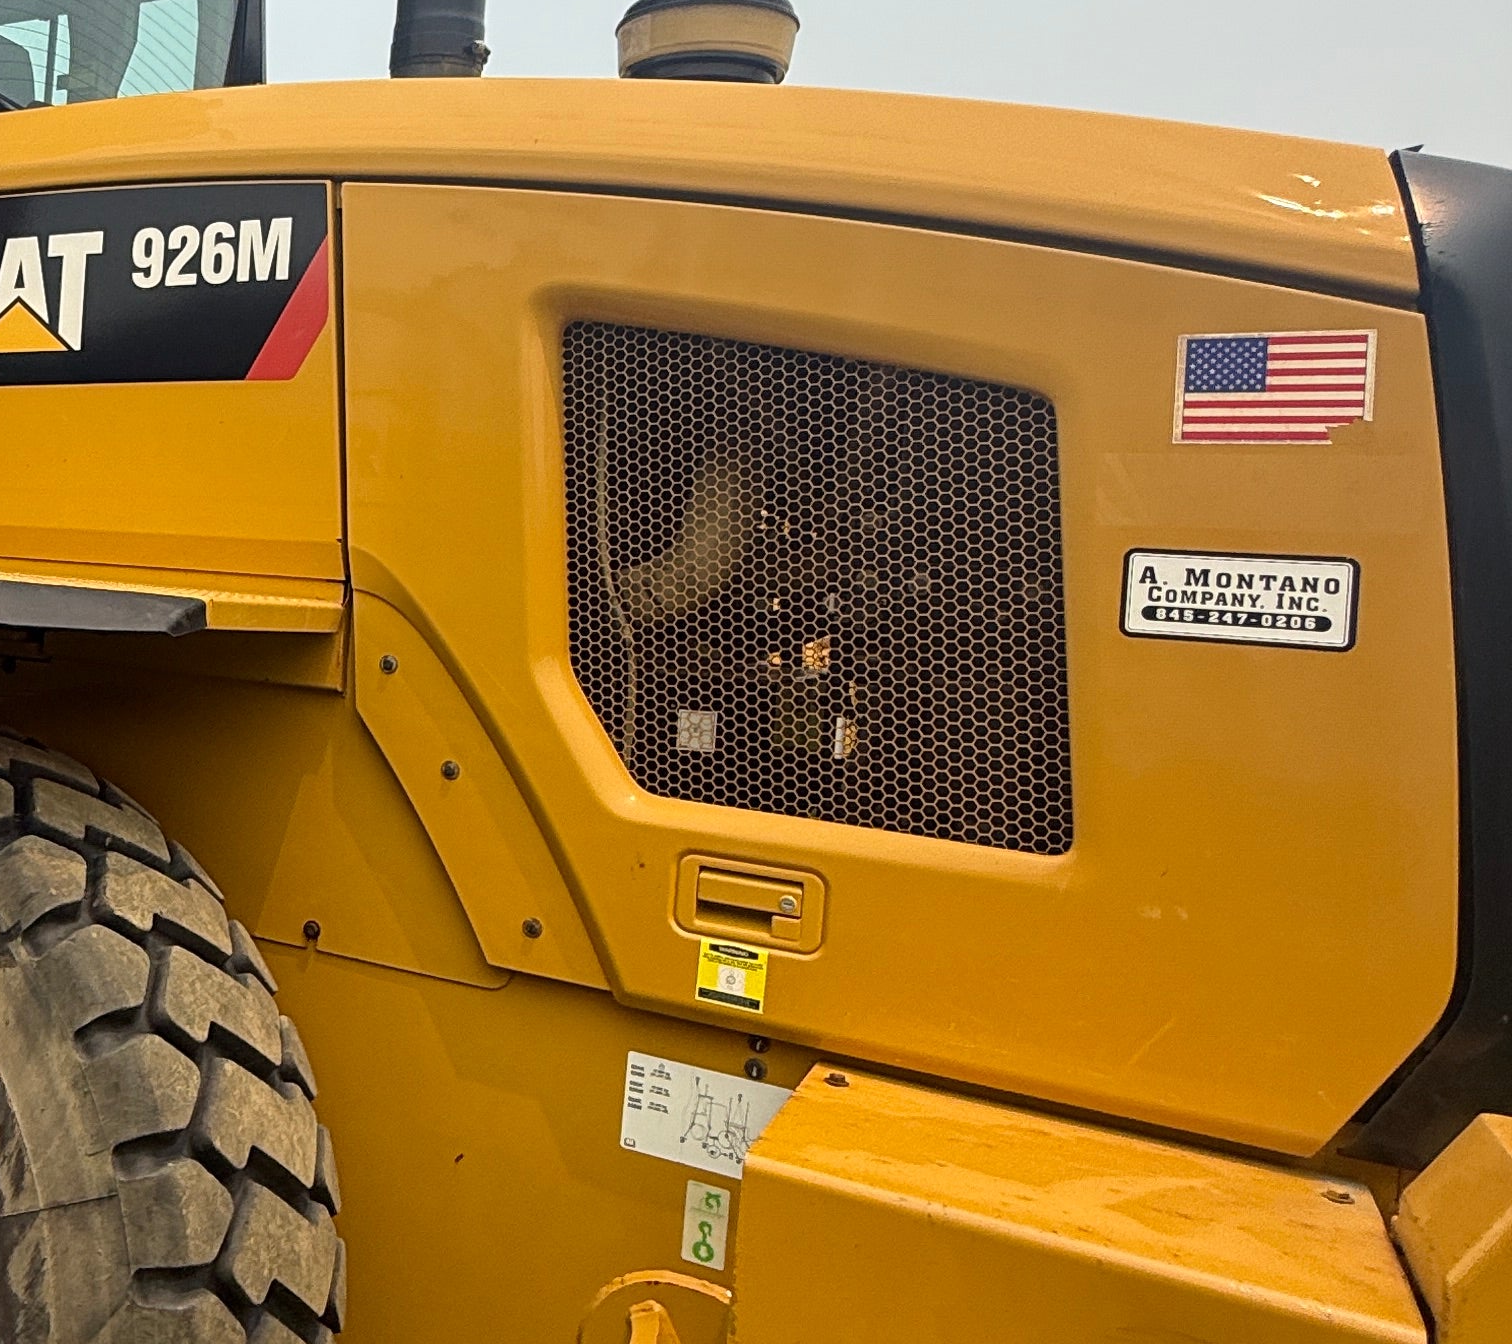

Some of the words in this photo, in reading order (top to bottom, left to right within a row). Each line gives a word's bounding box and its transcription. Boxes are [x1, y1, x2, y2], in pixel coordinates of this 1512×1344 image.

[131, 217, 293, 289] 926M
[1138, 565, 1169, 586] A.
[1184, 568, 1341, 596] MONTANO
[1276, 593, 1328, 613] INC.
[1154, 607, 1317, 629] 845-247-0206
